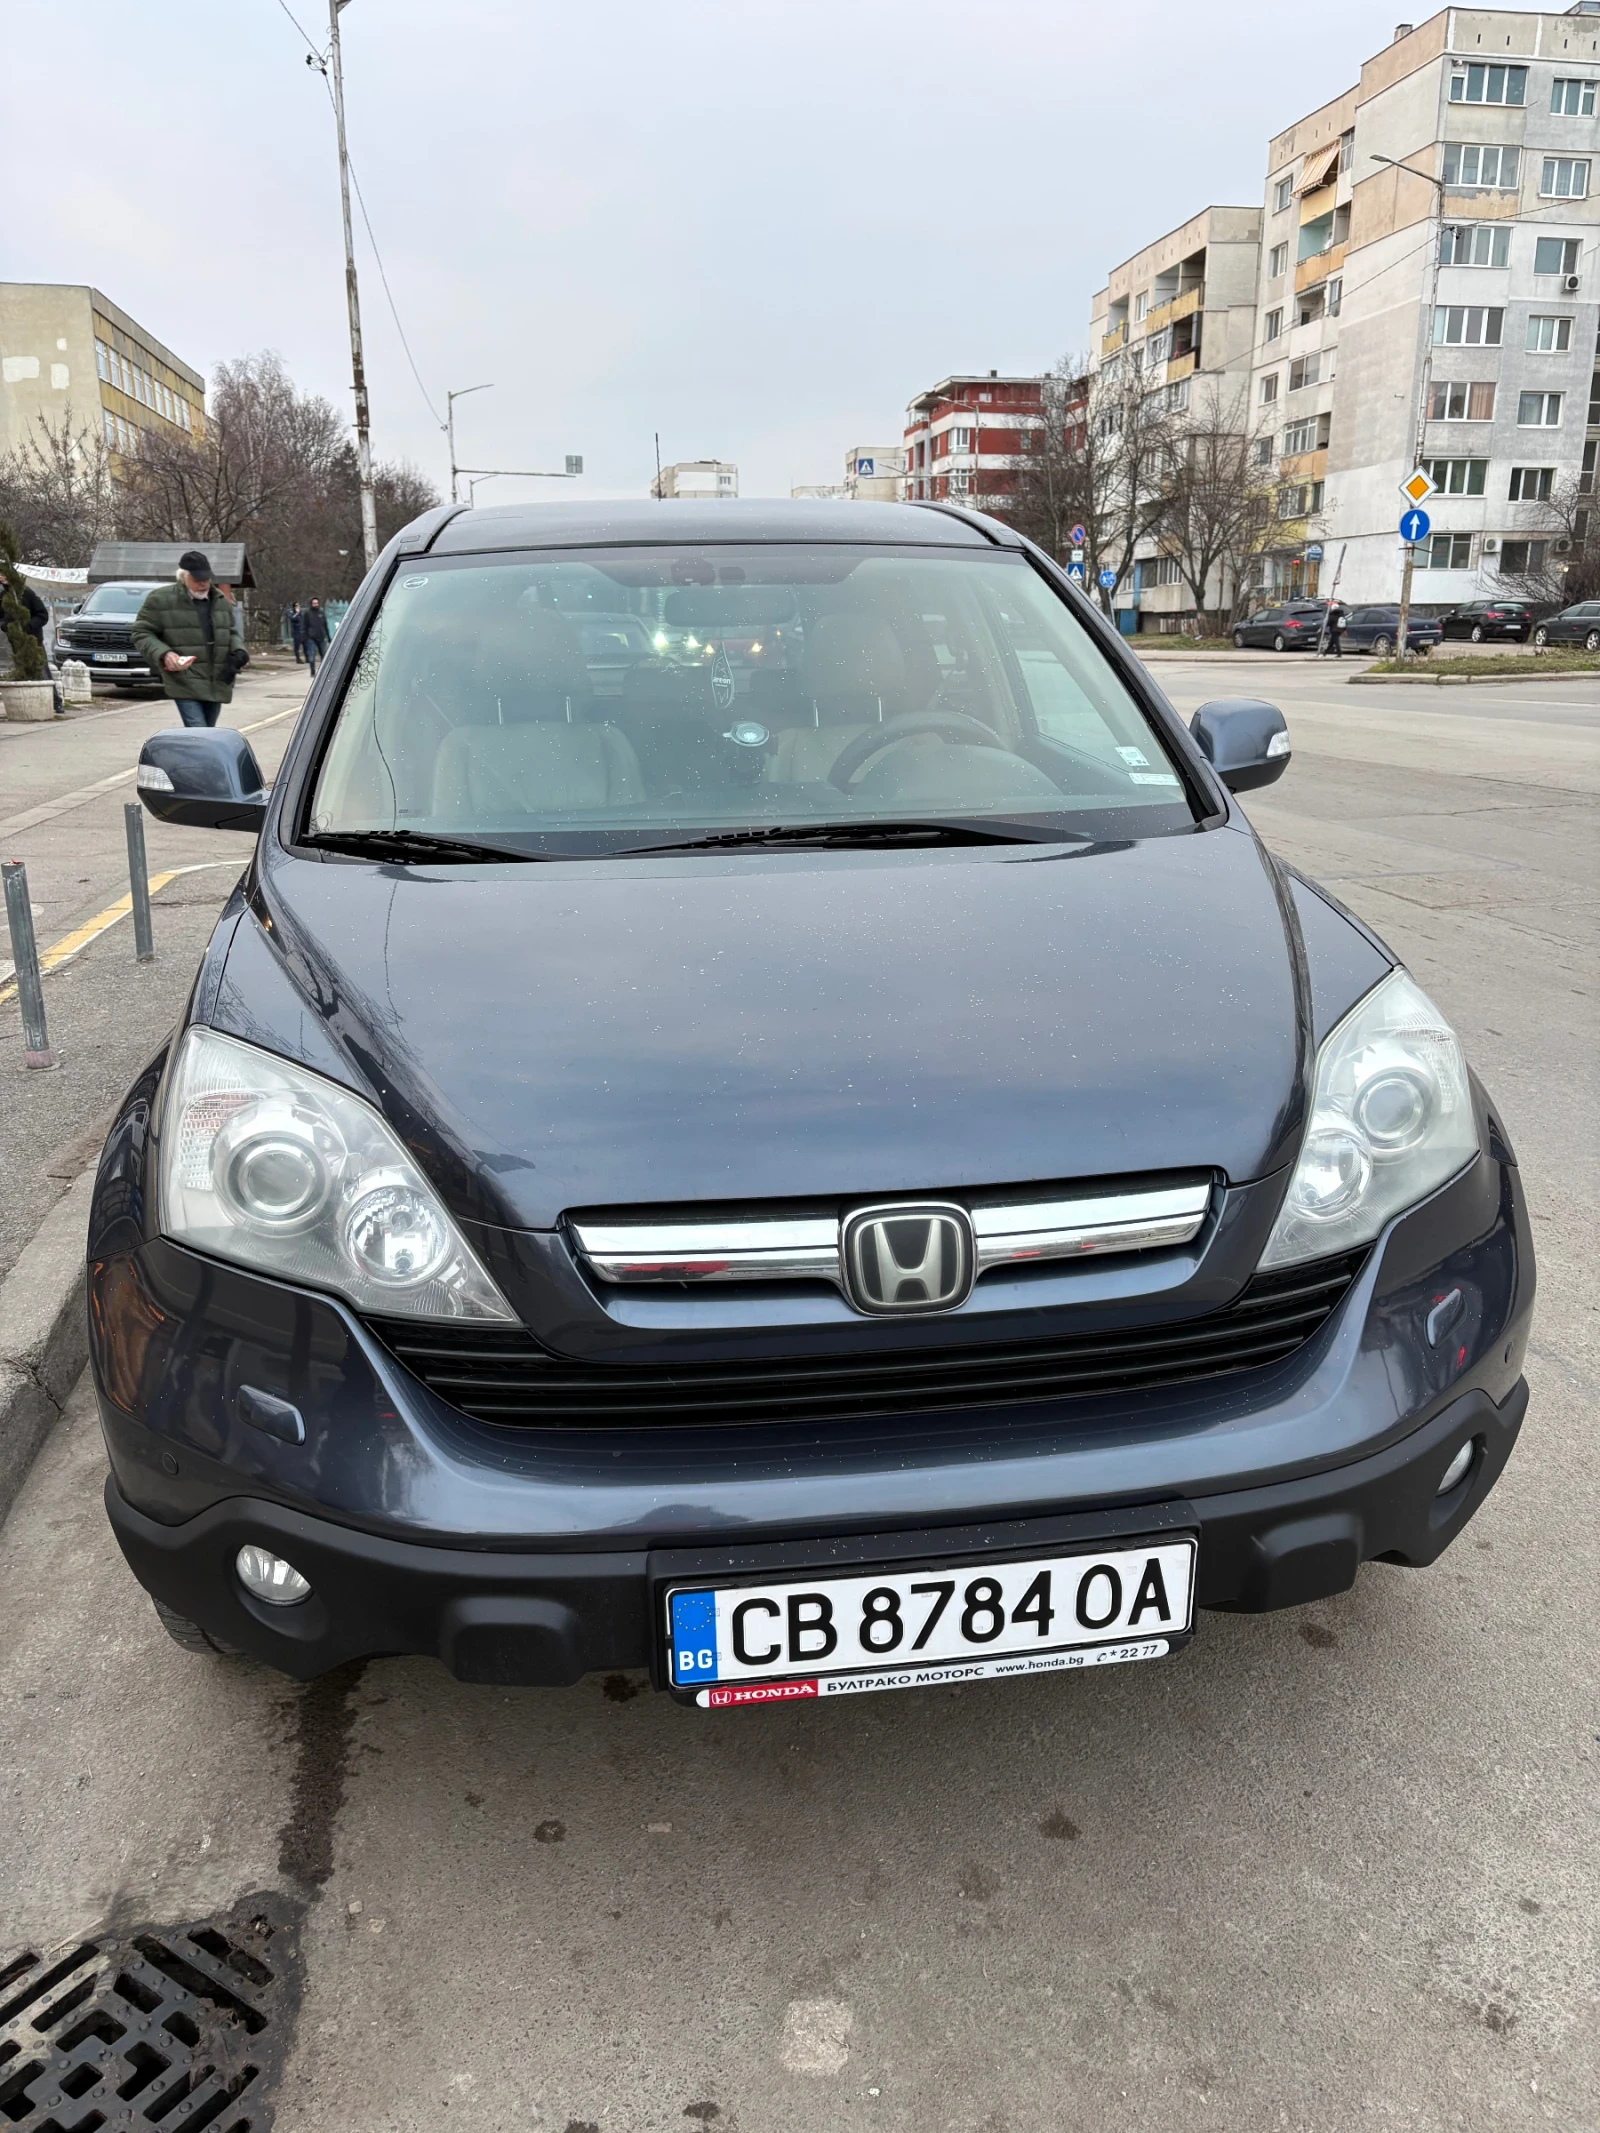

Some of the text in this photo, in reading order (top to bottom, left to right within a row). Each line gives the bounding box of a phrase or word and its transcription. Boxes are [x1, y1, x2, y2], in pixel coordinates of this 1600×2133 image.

[712, 676, 731, 685] areon
[732, 1557, 1172, 1666] CB 8784 OA
[679, 1649, 713, 1671] BG
[995, 1655, 1084, 1673] www.honda.bg
[827, 1667, 985, 1692] БУЛТРАКО МОТОРС
[733, 1684, 816, 1701] HONDA
